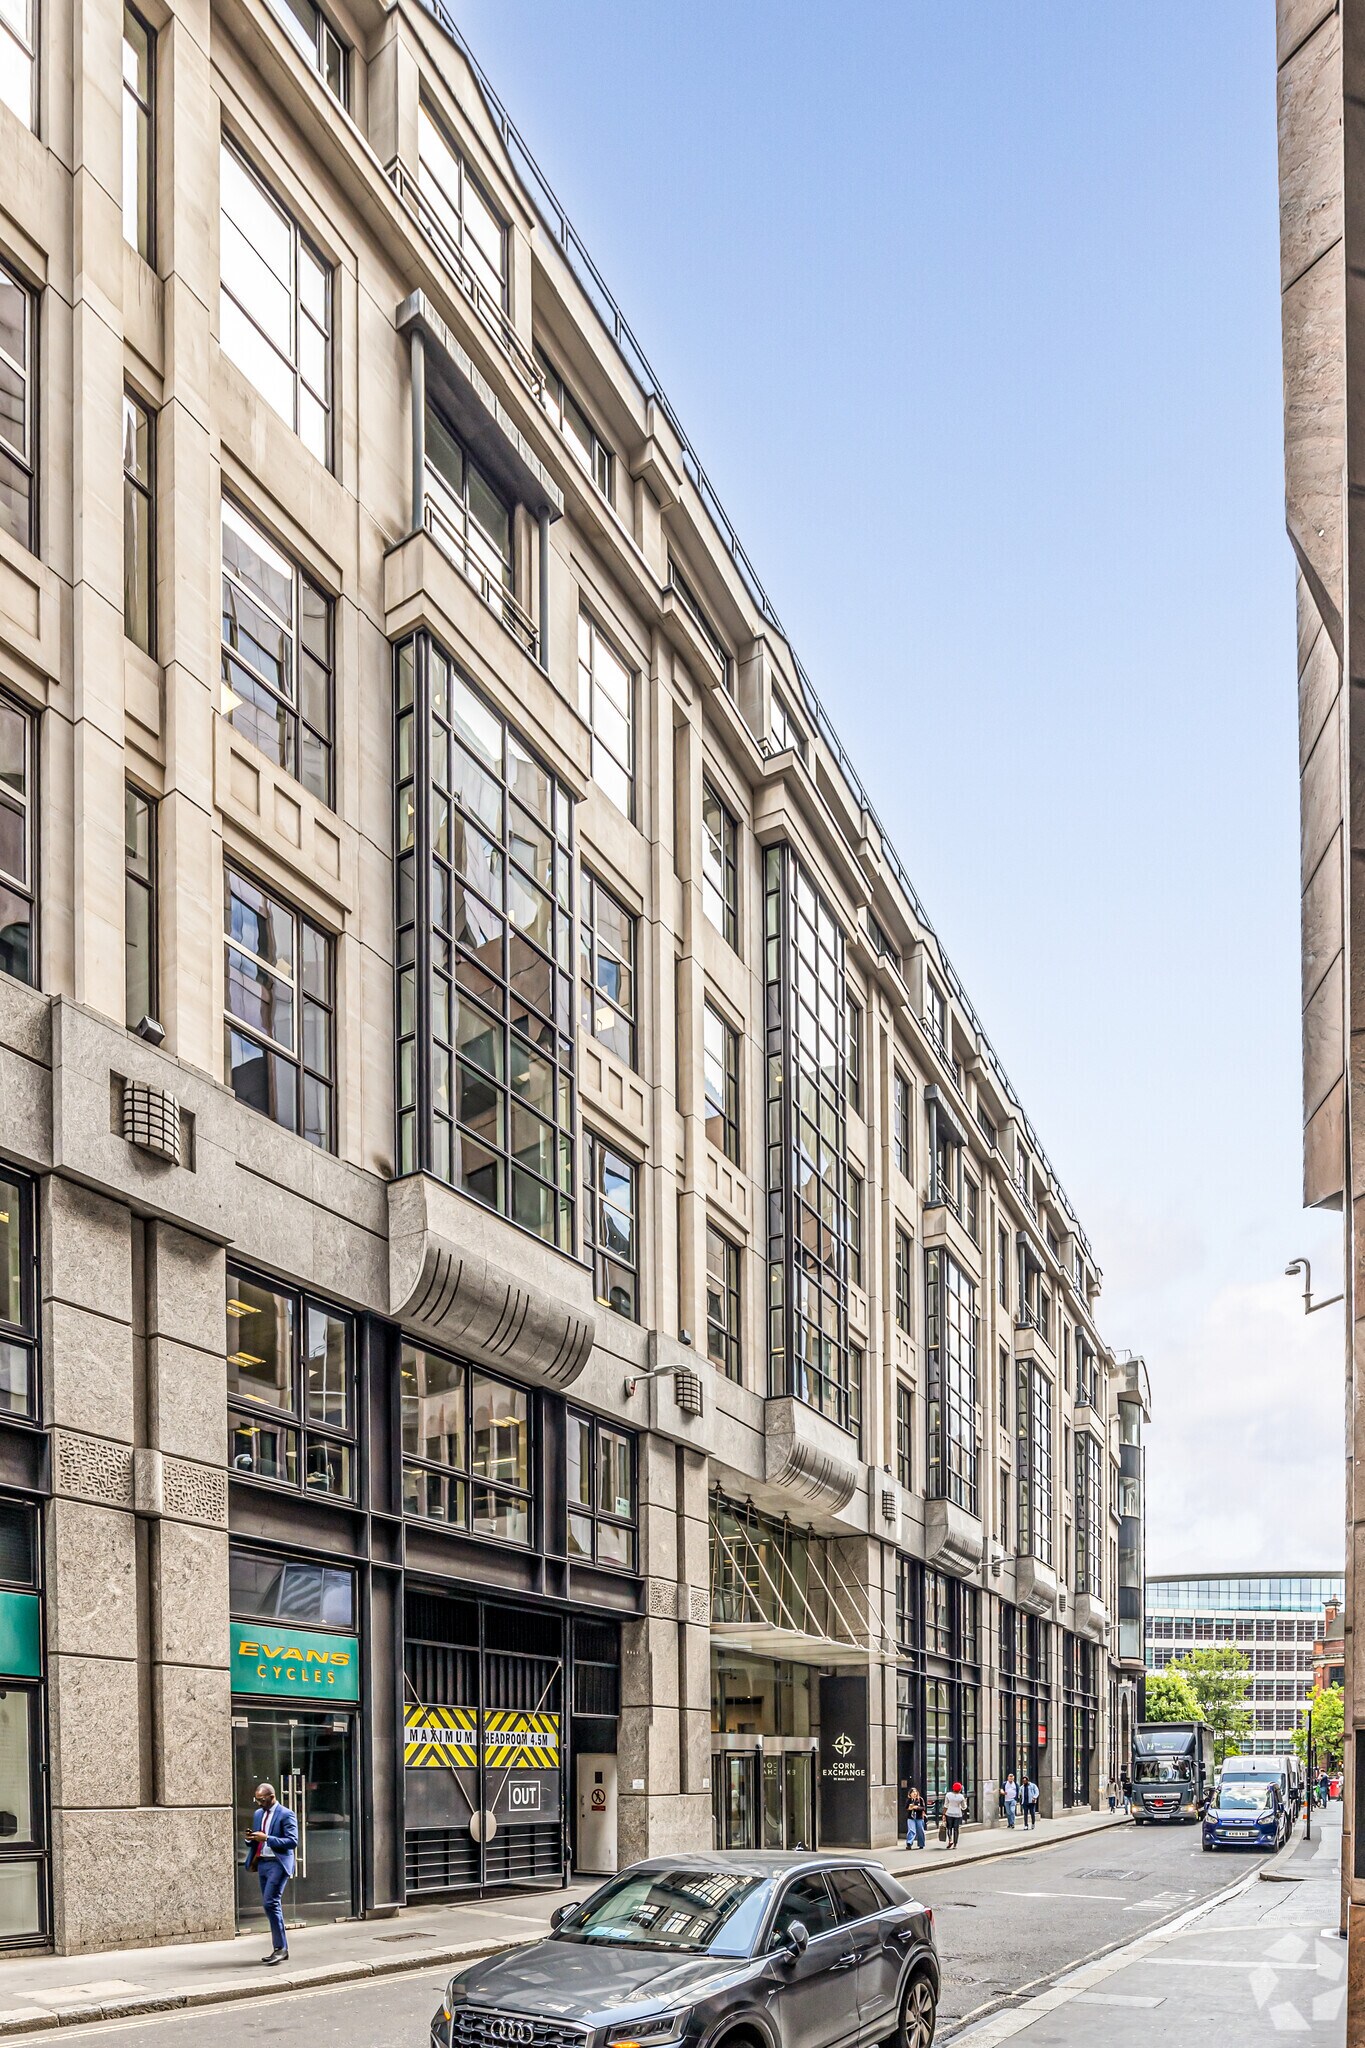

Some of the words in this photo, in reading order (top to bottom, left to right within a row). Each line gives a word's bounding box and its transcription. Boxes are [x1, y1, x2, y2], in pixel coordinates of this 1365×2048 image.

[238, 1641, 350, 1666] EVANS
[257, 1664, 335, 1684] CYCLES
[409, 1729, 473, 1744] MAXIMUM
[485, 1732, 528, 1746] HEADROOM
[530, 1735, 548, 1746] 4.5M
[822, 1769, 866, 1777] EXCHANGE
[832, 1762, 856, 1770] CORN
[512, 1787, 537, 1805] OUT
